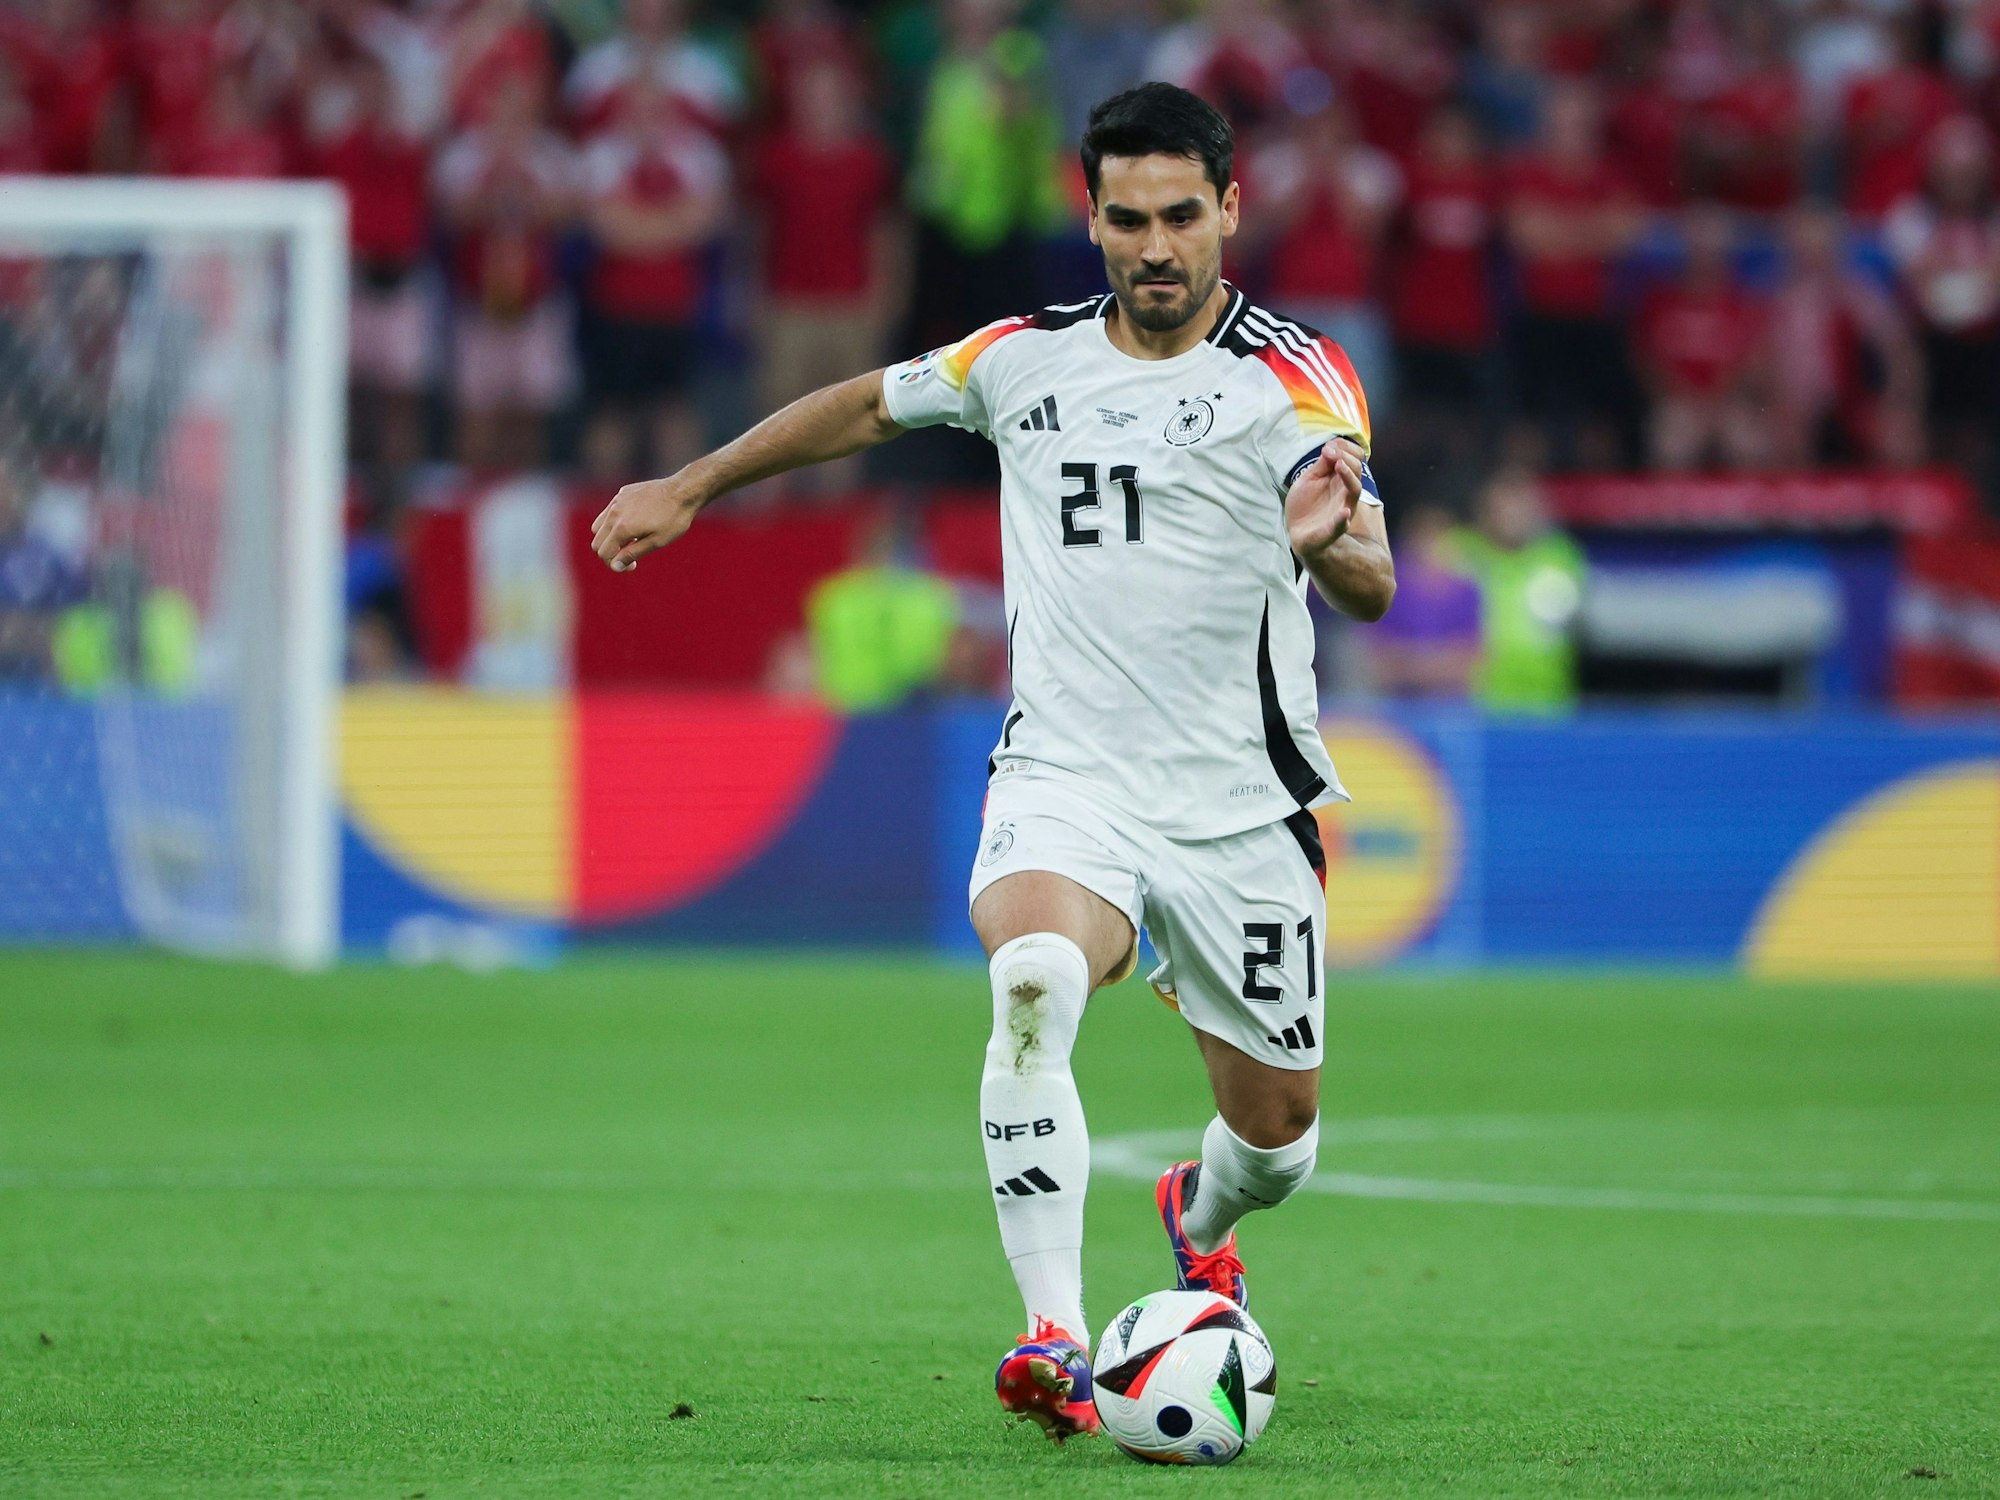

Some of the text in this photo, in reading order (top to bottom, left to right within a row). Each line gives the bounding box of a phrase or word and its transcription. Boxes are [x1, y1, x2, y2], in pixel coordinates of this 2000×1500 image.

[1061, 462, 1144, 548] 21
[1229, 784, 1269, 798] HEAT RDY
[1242, 914, 1317, 1004] 21
[985, 1117, 1056, 1141] DFB
